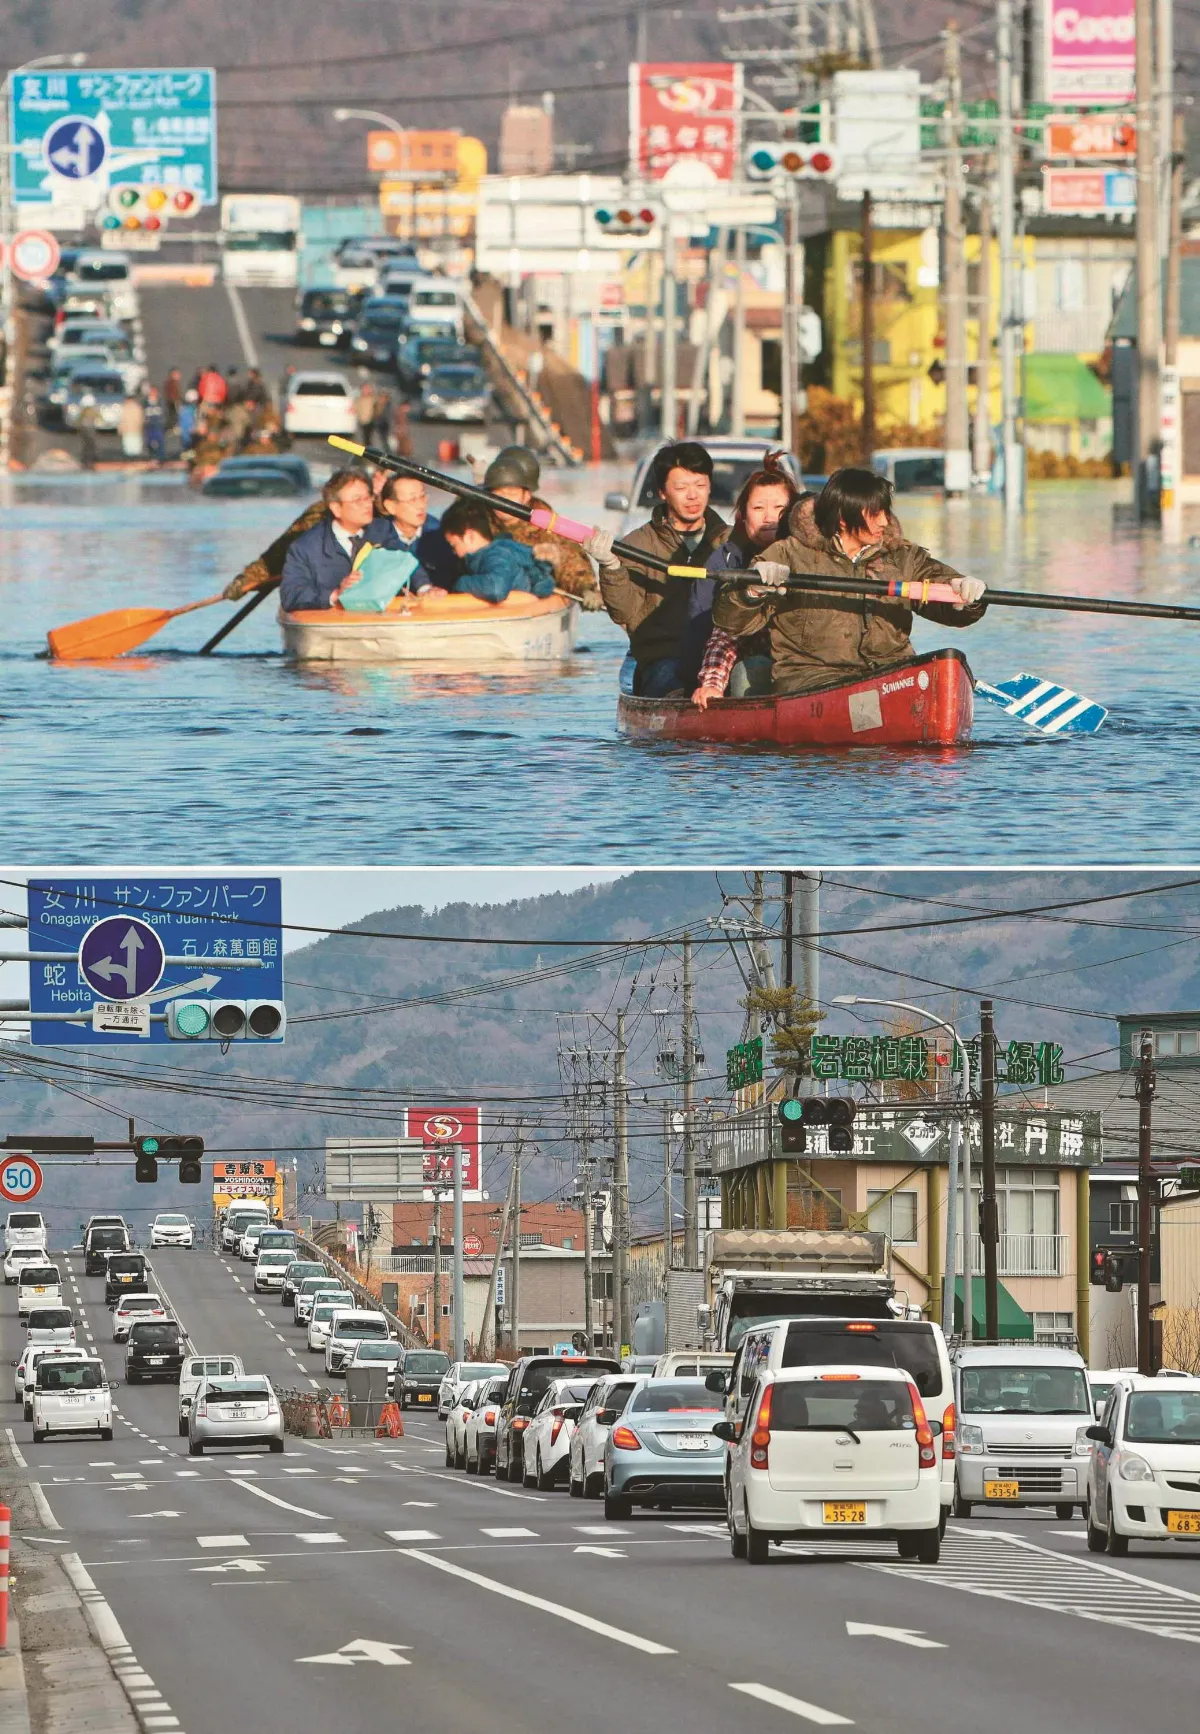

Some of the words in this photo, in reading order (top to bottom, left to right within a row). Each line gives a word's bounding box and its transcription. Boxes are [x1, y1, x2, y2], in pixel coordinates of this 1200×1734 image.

[882, 677, 914, 695] SUWANNEE
[42, 885, 96, 910] 女川
[114, 884, 267, 908] サン・ファンパーク
[40, 912, 99, 928] Onagawa
[142, 912, 171, 925] Sant
[176, 913, 207, 925] Juan
[211, 912, 239, 925] Park
[182, 938, 278, 958] 石ノ森萬画館
[51, 989, 92, 1002] Hebita
[97, 1004, 145, 1015] 自転車を除く
[104, 1015, 139, 1025] 一方通行
[813, 1035, 928, 1080] 岩盤植栽
[948, 1121, 1014, 1147] 株式社
[224, 1163, 265, 1175] 吉野家
[6, 1168, 32, 1189] 50
[496, 1269, 504, 1303] 日本共産党
[992, 1489, 1017, 1497] 53-54
[833, 1511, 865, 1522] 35-28
